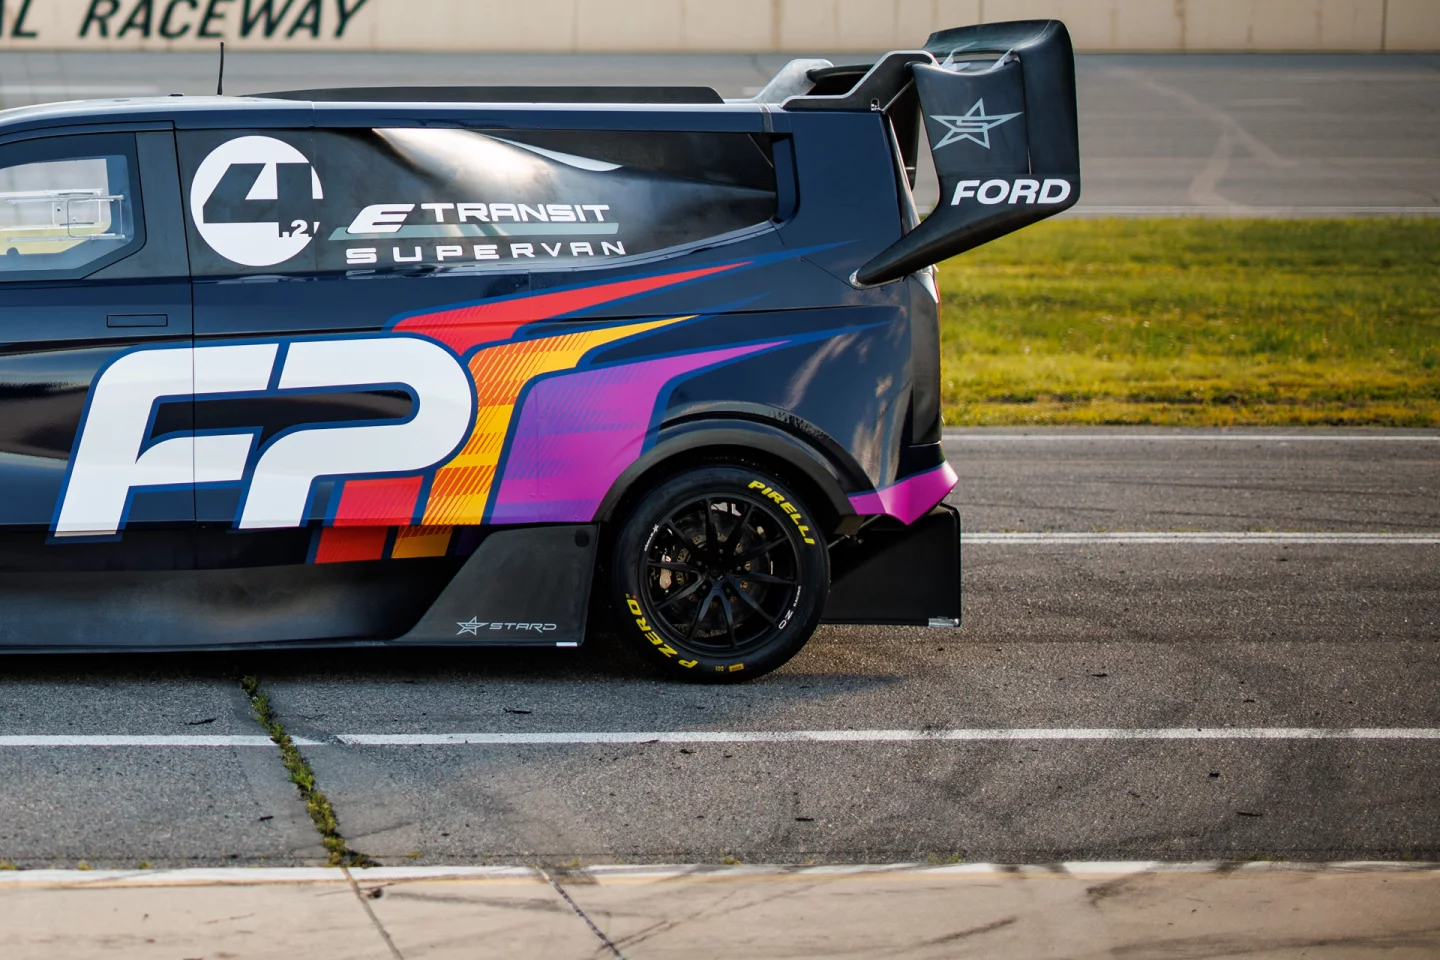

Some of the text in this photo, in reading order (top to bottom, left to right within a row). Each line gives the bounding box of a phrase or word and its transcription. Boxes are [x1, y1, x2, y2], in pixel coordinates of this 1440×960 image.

[951, 178, 1071, 205] FORD
[420, 202, 610, 223] TRANSIT
[346, 240, 626, 264] SUPERVAN
[54, 337, 472, 537] FP
[748, 480, 815, 545] PIRELLI
[488, 622, 558, 634] STARD
[626, 599, 699, 669] P ZERO
